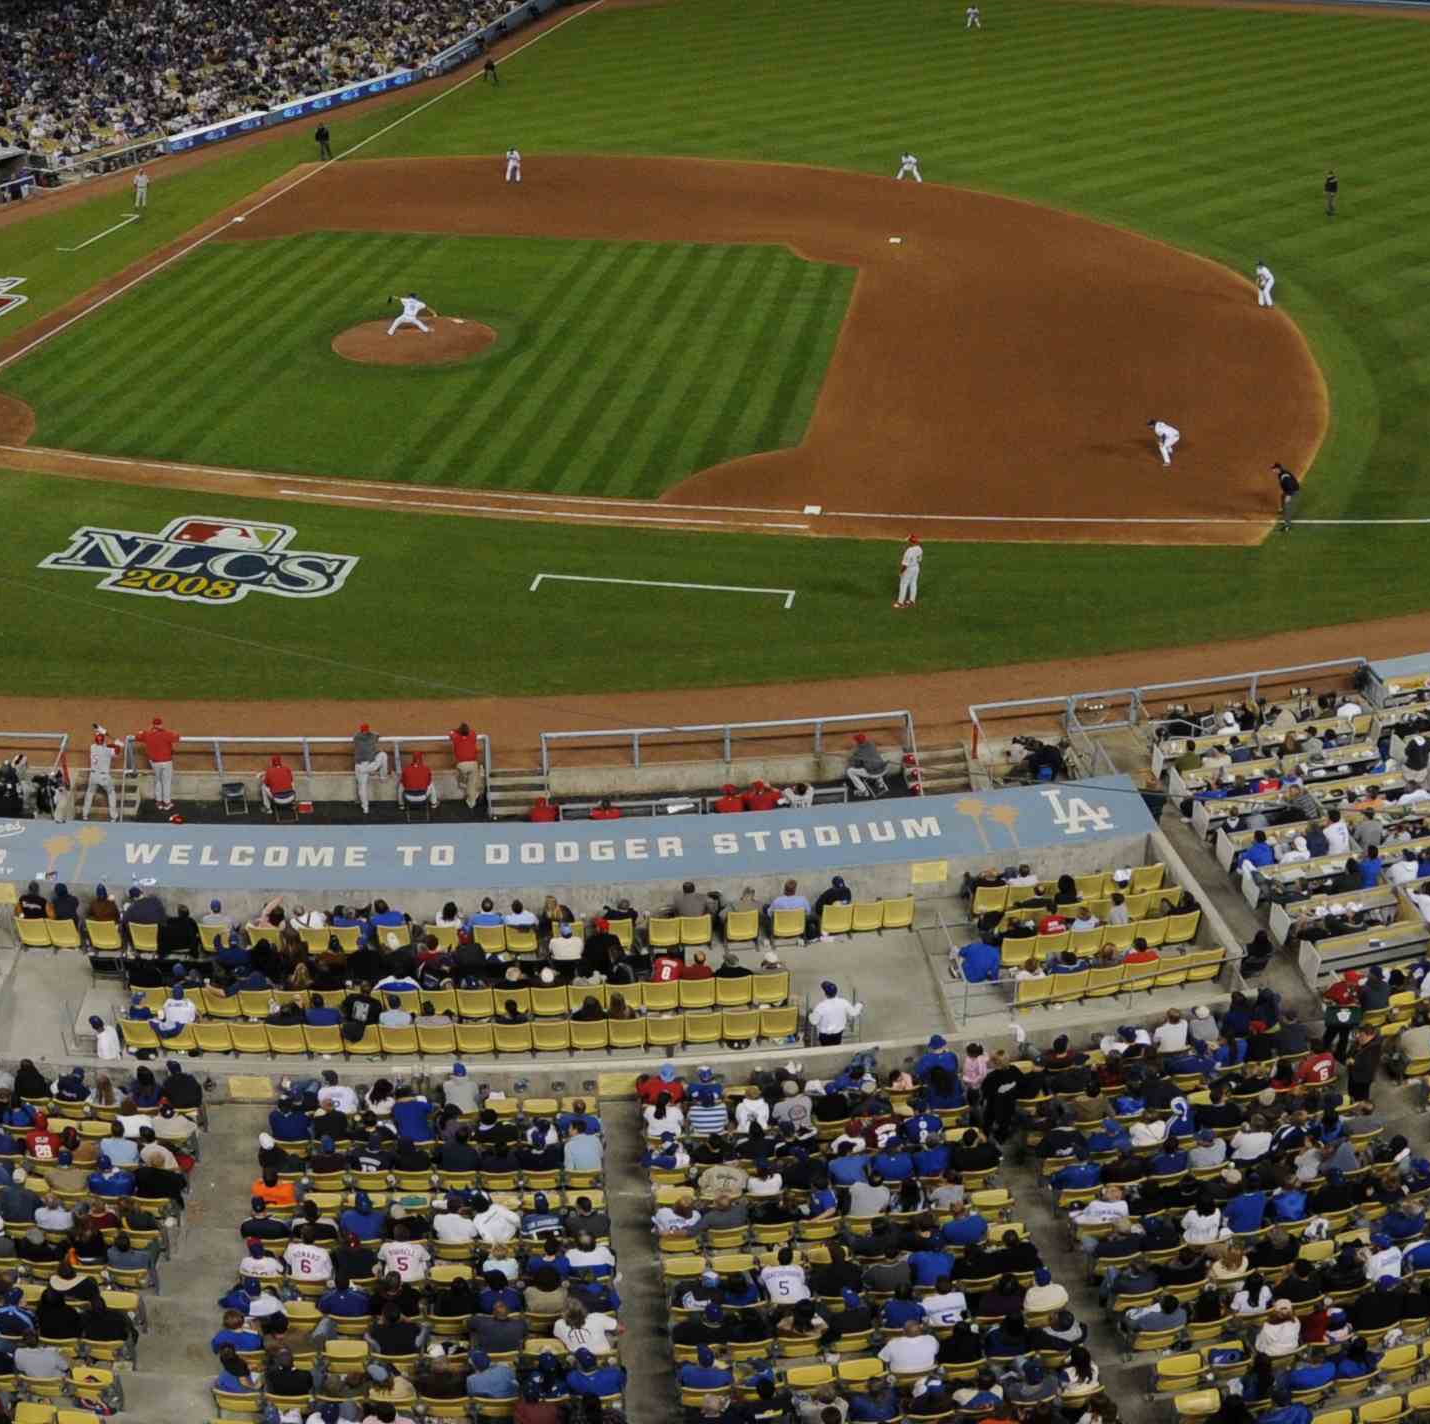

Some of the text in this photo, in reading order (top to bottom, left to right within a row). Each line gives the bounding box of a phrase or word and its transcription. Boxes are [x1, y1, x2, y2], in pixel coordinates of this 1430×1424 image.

[55, 531, 346, 590] NLCS
[121, 568, 238, 599] 2008
[1039, 789, 1115, 835] LA
[124, 815, 942, 868] WELCOME TO DODGER STADIUM
[300, 1259, 311, 1274] 6
[397, 1256, 408, 1272] 5
[778, 1280, 789, 1296] 5
